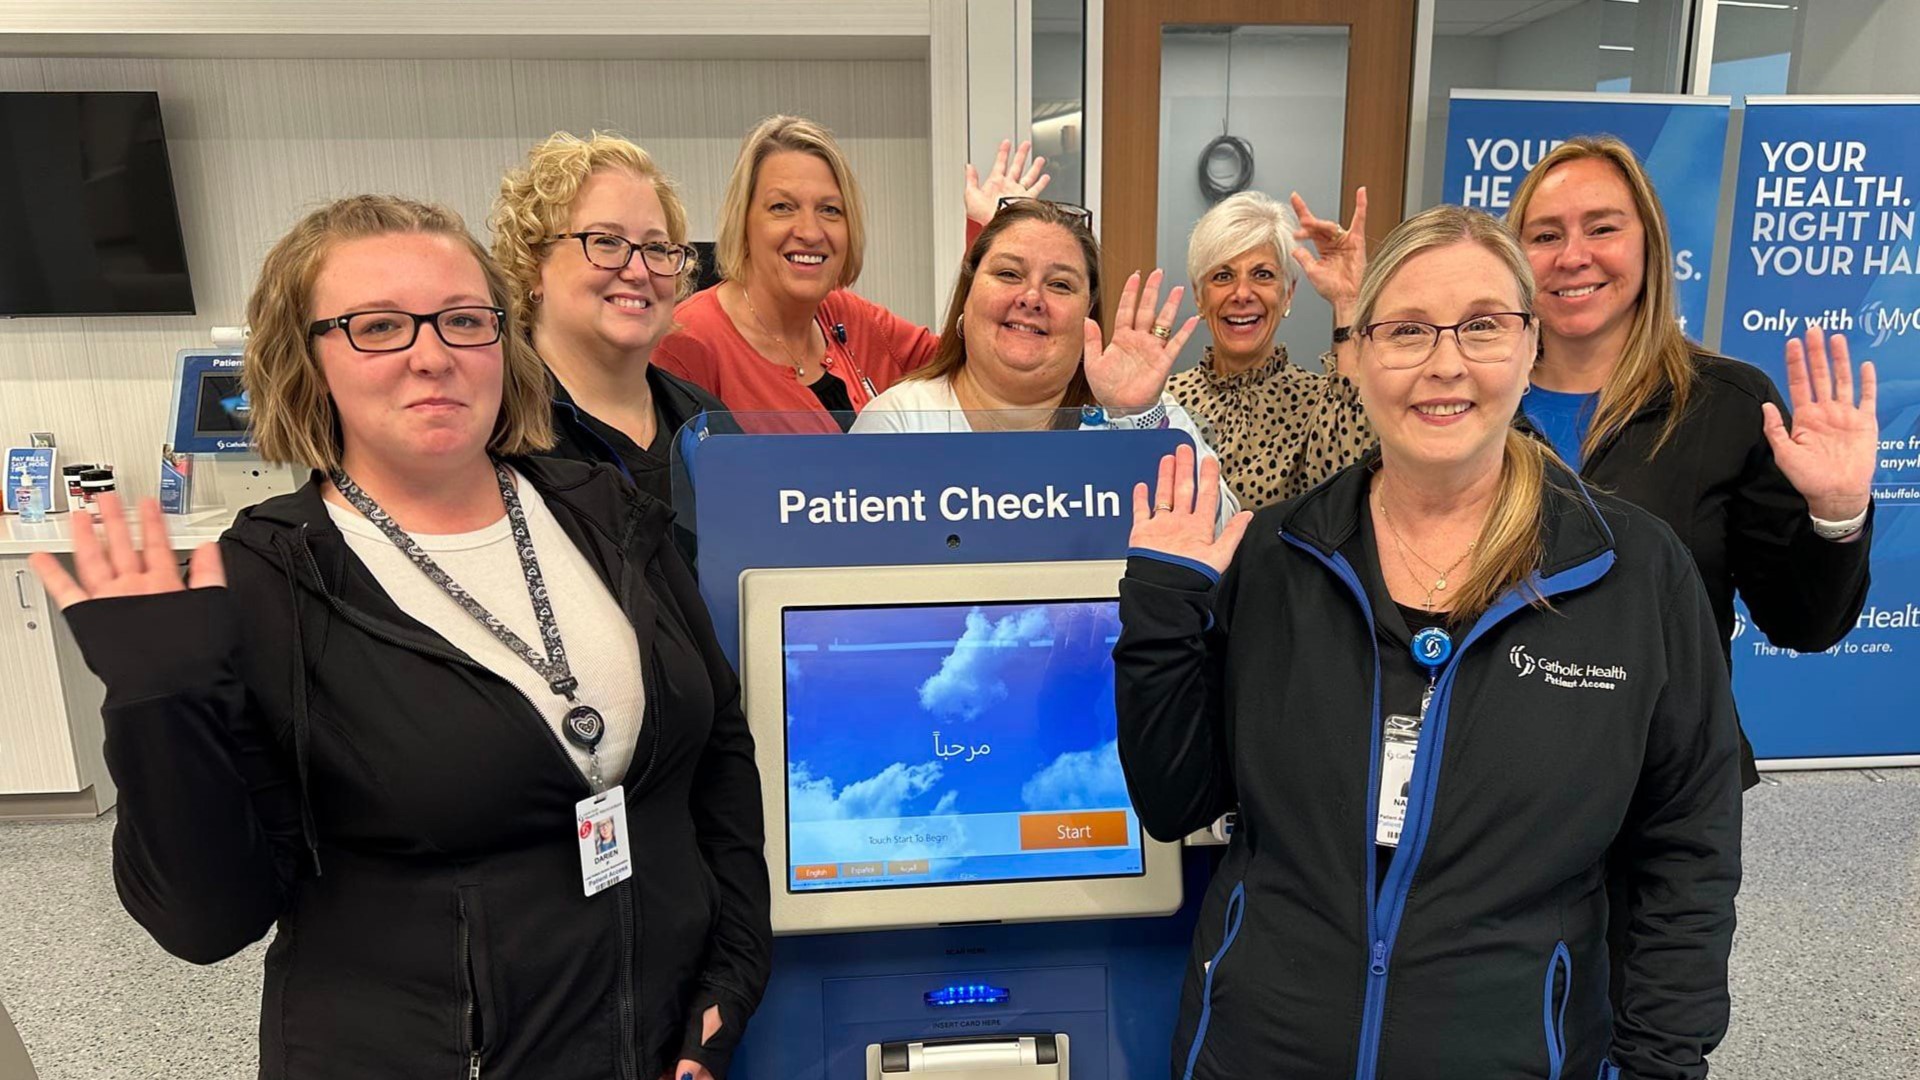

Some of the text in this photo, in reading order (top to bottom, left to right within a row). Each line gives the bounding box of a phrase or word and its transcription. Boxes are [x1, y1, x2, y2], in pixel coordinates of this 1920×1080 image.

[1761, 141, 1866, 173] YOUR
[1756, 176, 1911, 207] HEALTH.
[1752, 211, 1915, 242] RIGHT IN
[1750, 245, 1920, 276] YOUR HA
[1742, 308, 1798, 337] Only
[1804, 308, 1853, 331] with
[779, 484, 1121, 523] Patient Check-In
[1753, 642, 1777, 656] The
[1845, 642, 1858, 654] to
[1861, 643, 1893, 653] care.
[1537, 658, 1627, 680] Catholic Health
[1544, 673, 1615, 690] Patient Access
[932, 731, 990, 761] مرحباً
[869, 833, 948, 845] Touch Start To Begin
[1057, 825, 1091, 840] Start
[594, 850, 619, 866] DARIEN
[806, 866, 874, 877] English Español
[933, 1019, 1001, 1029] INSERT CARD HERE
